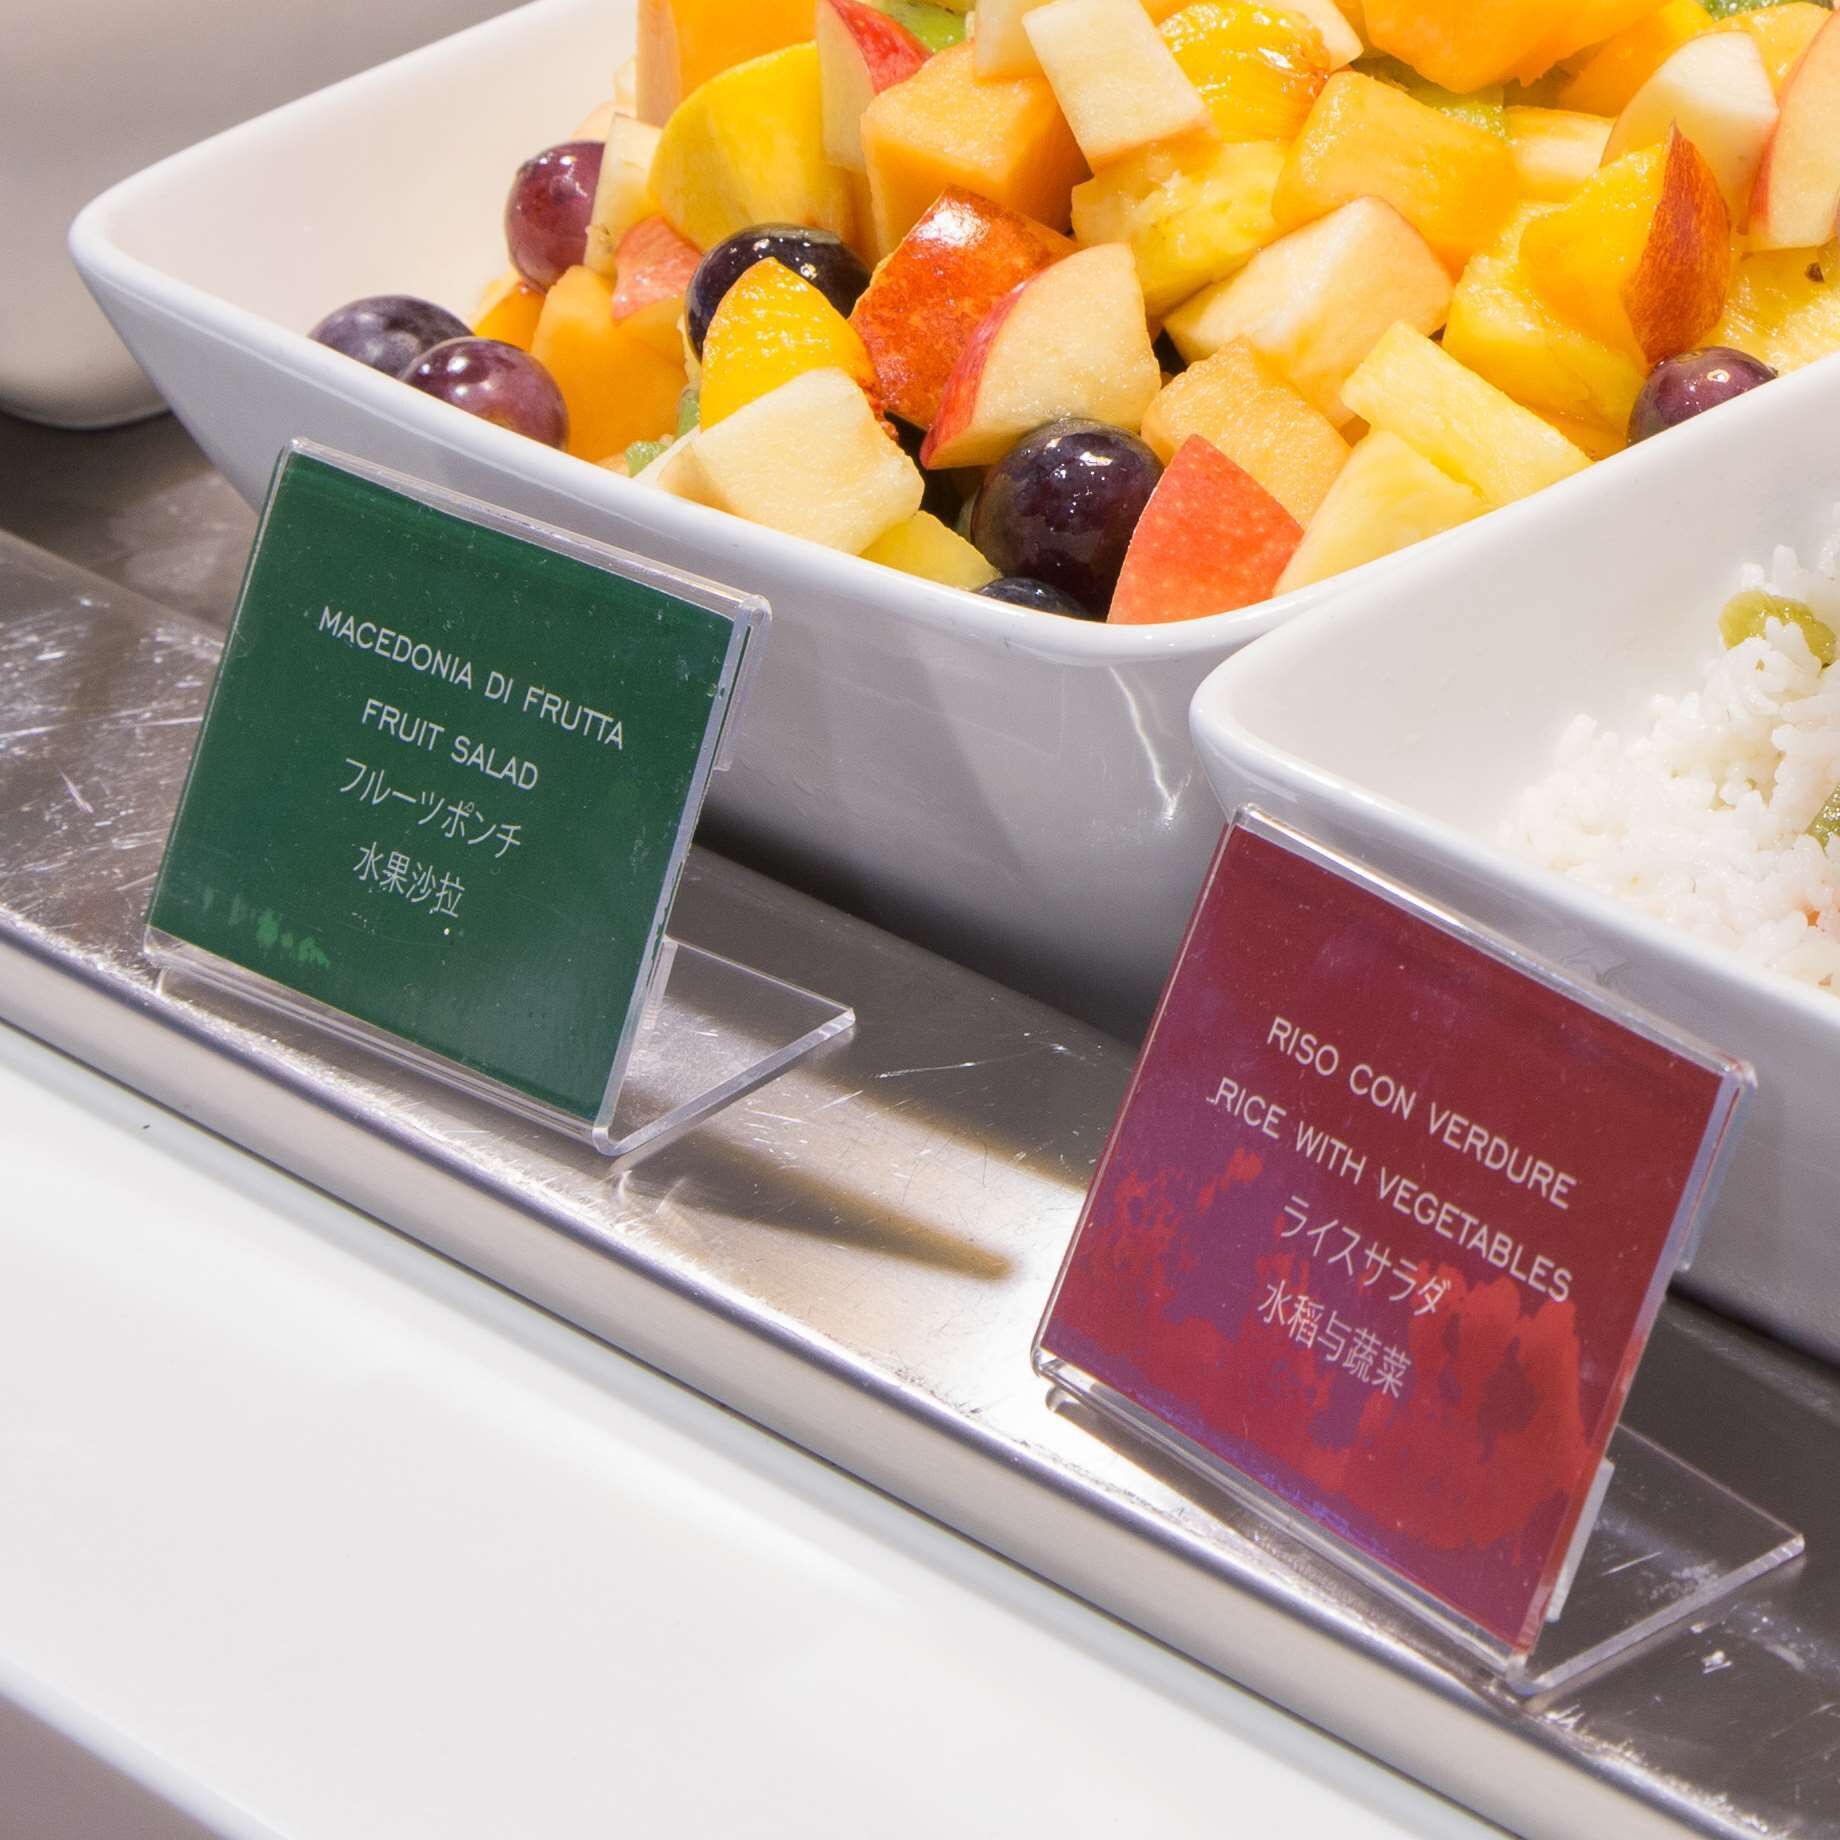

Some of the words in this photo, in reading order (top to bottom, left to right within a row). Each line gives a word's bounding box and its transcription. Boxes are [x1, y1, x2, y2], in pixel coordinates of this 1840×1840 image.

[318, 606, 473, 689] MACEDONIA
[485, 670, 512, 704] DI
[522, 686, 624, 750] FRUTTA
[361, 699, 444, 752] FRUIT
[451, 735, 538, 790] SALAD
[339, 758, 522, 858] フルーツポンチ
[353, 841, 466, 917] 水果沙拉
[1267, 1017, 1339, 1077] RISO
[1350, 1064, 1416, 1120] CON
[1429, 1103, 1577, 1209] VERDURE
[1216, 1077, 1287, 1139] RICE
[1295, 1120, 1367, 1184] WITH
[1377, 1167, 1573, 1302] VEGETABLES
[1281, 1195, 1451, 1317] ライスサラダ
